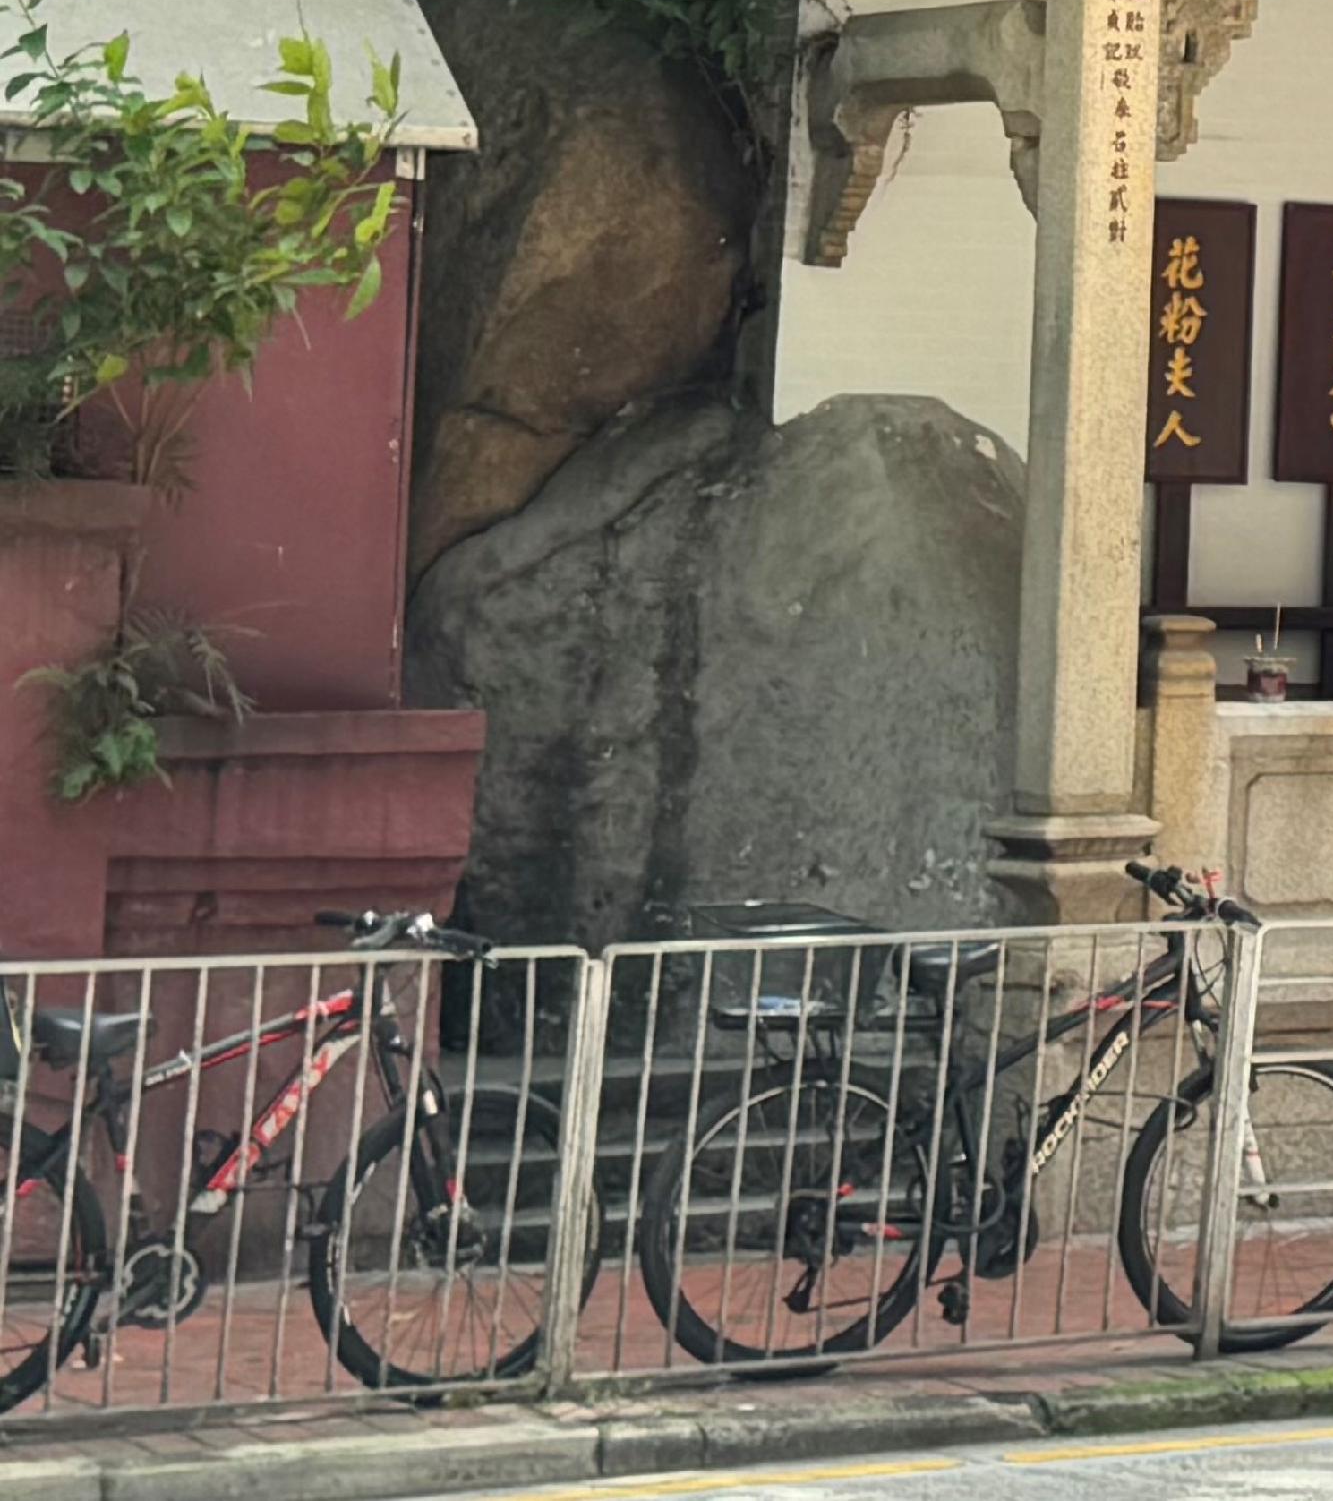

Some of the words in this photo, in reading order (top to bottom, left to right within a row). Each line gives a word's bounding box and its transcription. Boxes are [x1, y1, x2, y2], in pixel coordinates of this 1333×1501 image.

[1153, 234, 1208, 449] 花粉夫人
[1030, 1031, 1130, 1175] ROCKIDER
